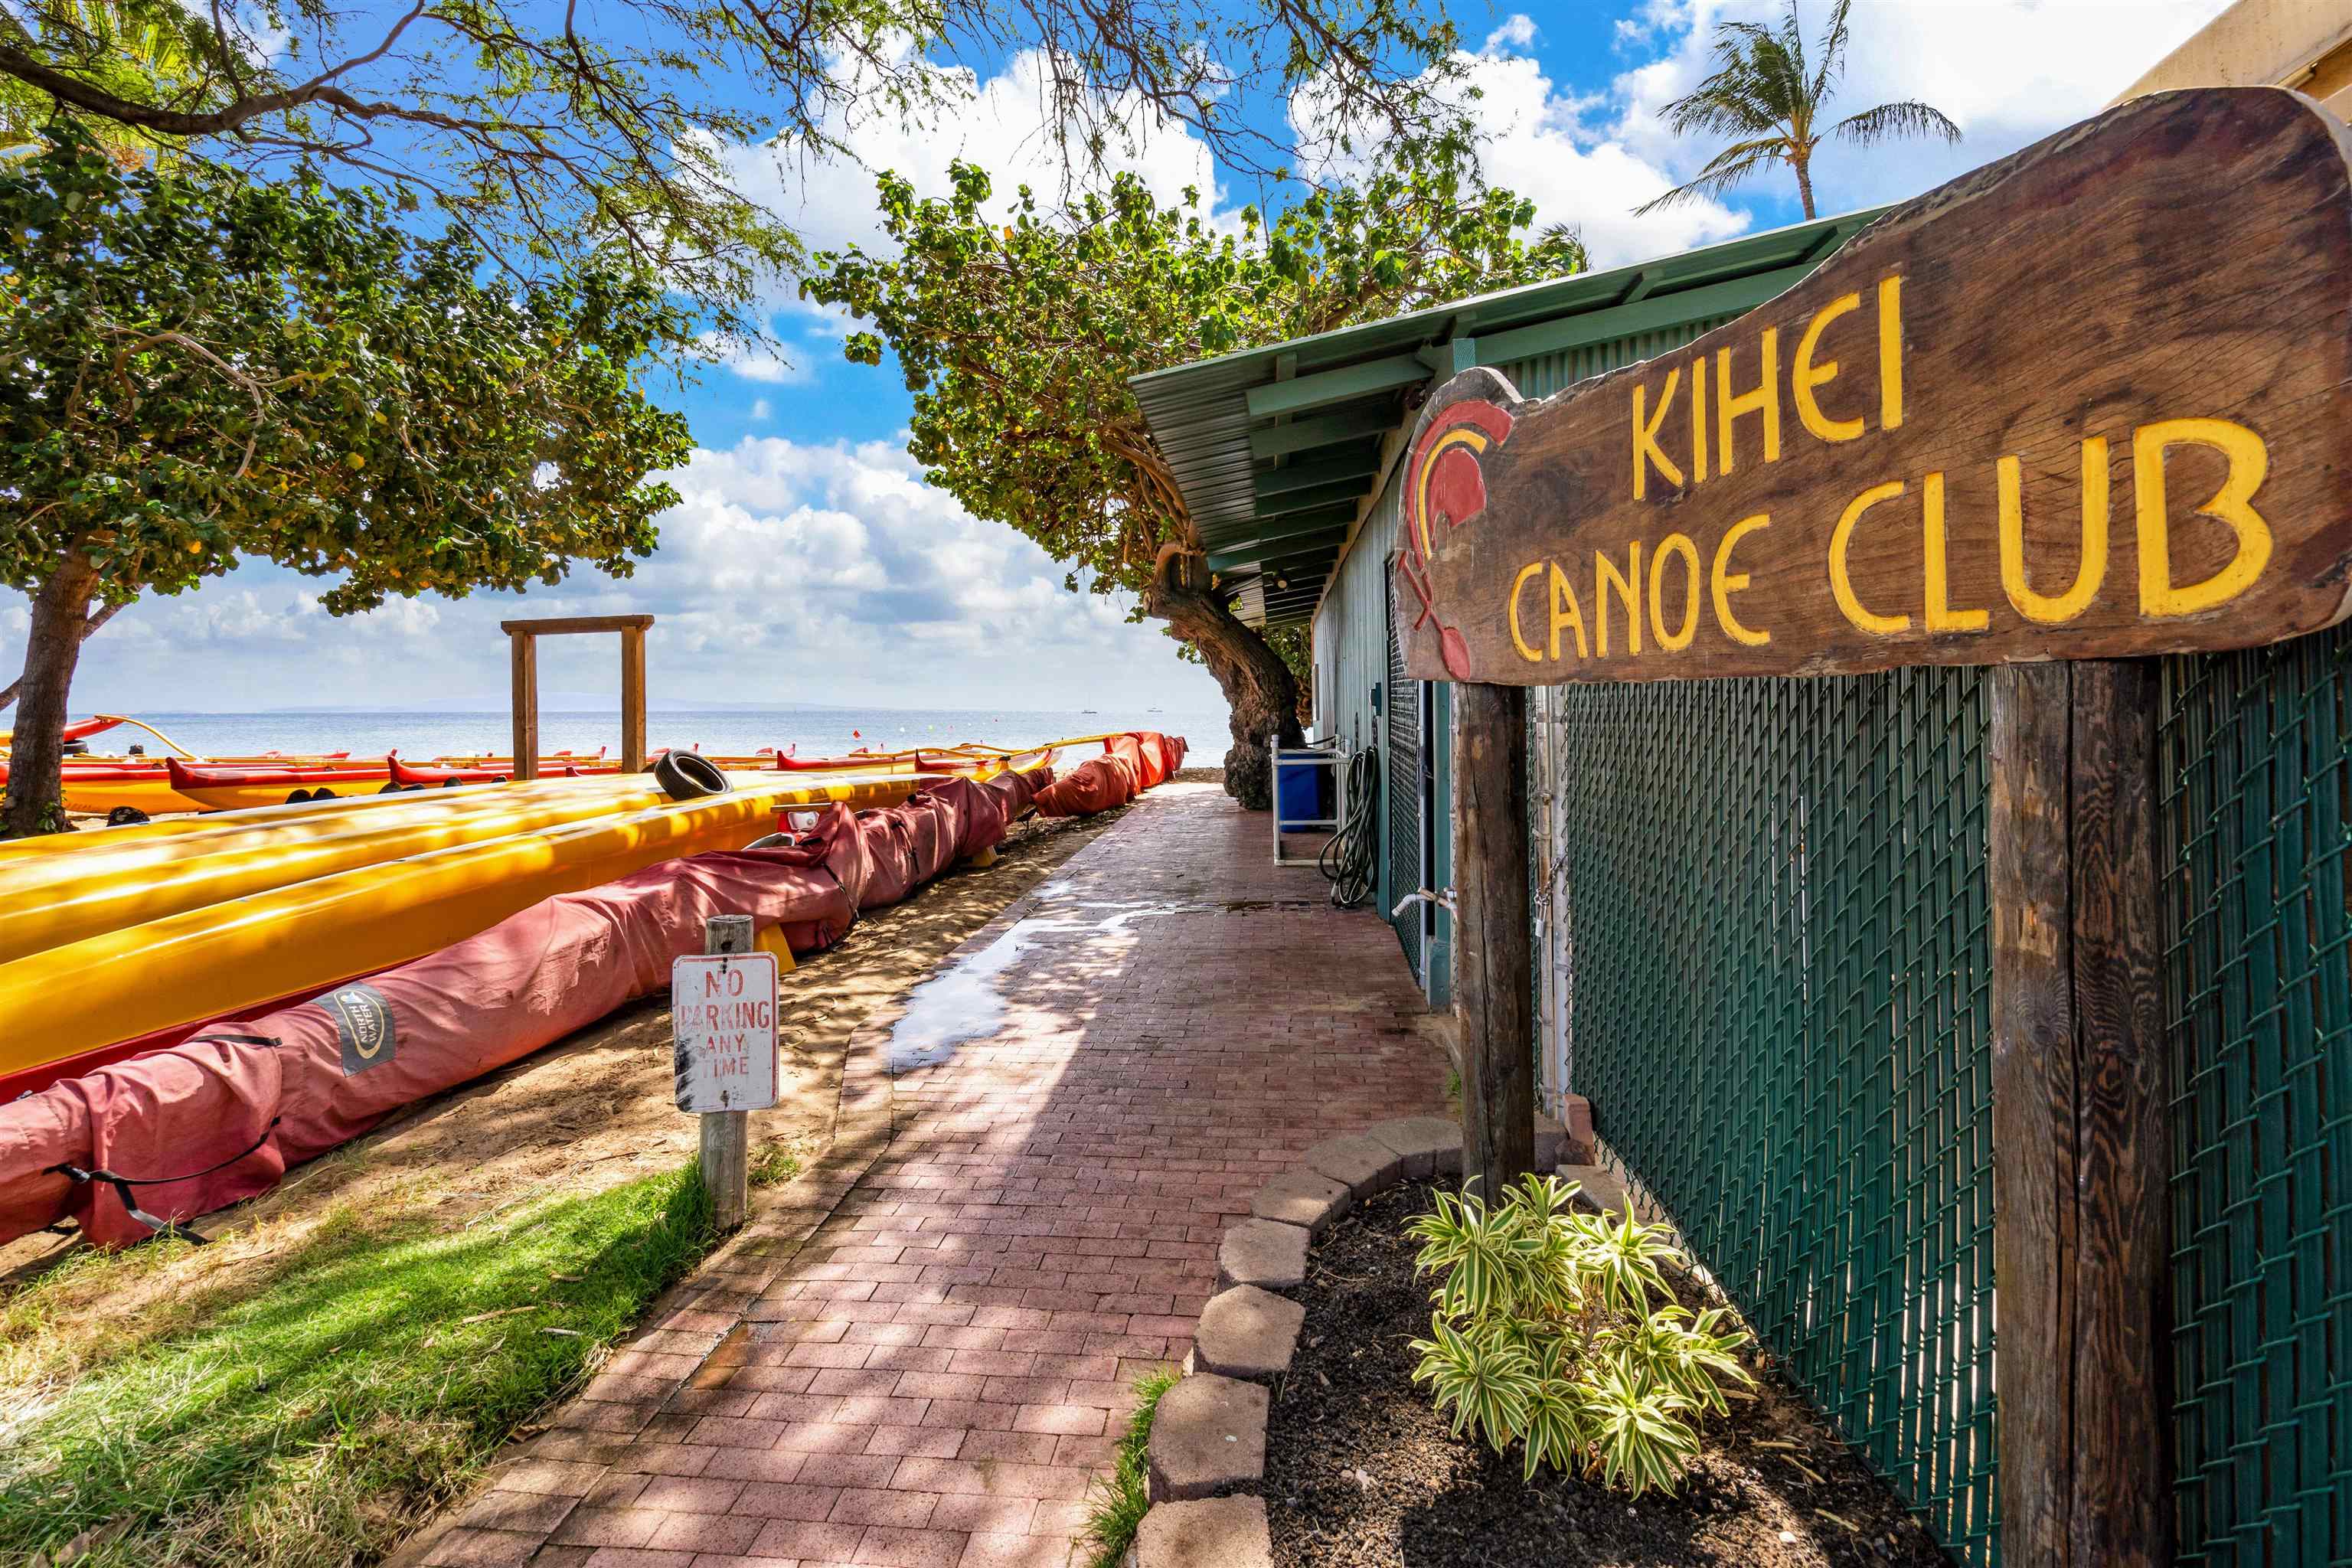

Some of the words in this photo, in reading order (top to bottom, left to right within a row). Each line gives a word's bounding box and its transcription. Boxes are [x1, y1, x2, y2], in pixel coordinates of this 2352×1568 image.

[1632, 274, 1903, 501] KIHEI
[1508, 514, 1772, 663] CANOE
[1828, 418, 2274, 635] CLUB
[705, 969, 744, 998] NO
[349, 1005, 368, 1041] NORTH
[359, 1004, 377, 1041] WATER
[706, 1033, 746, 1054] ANY
